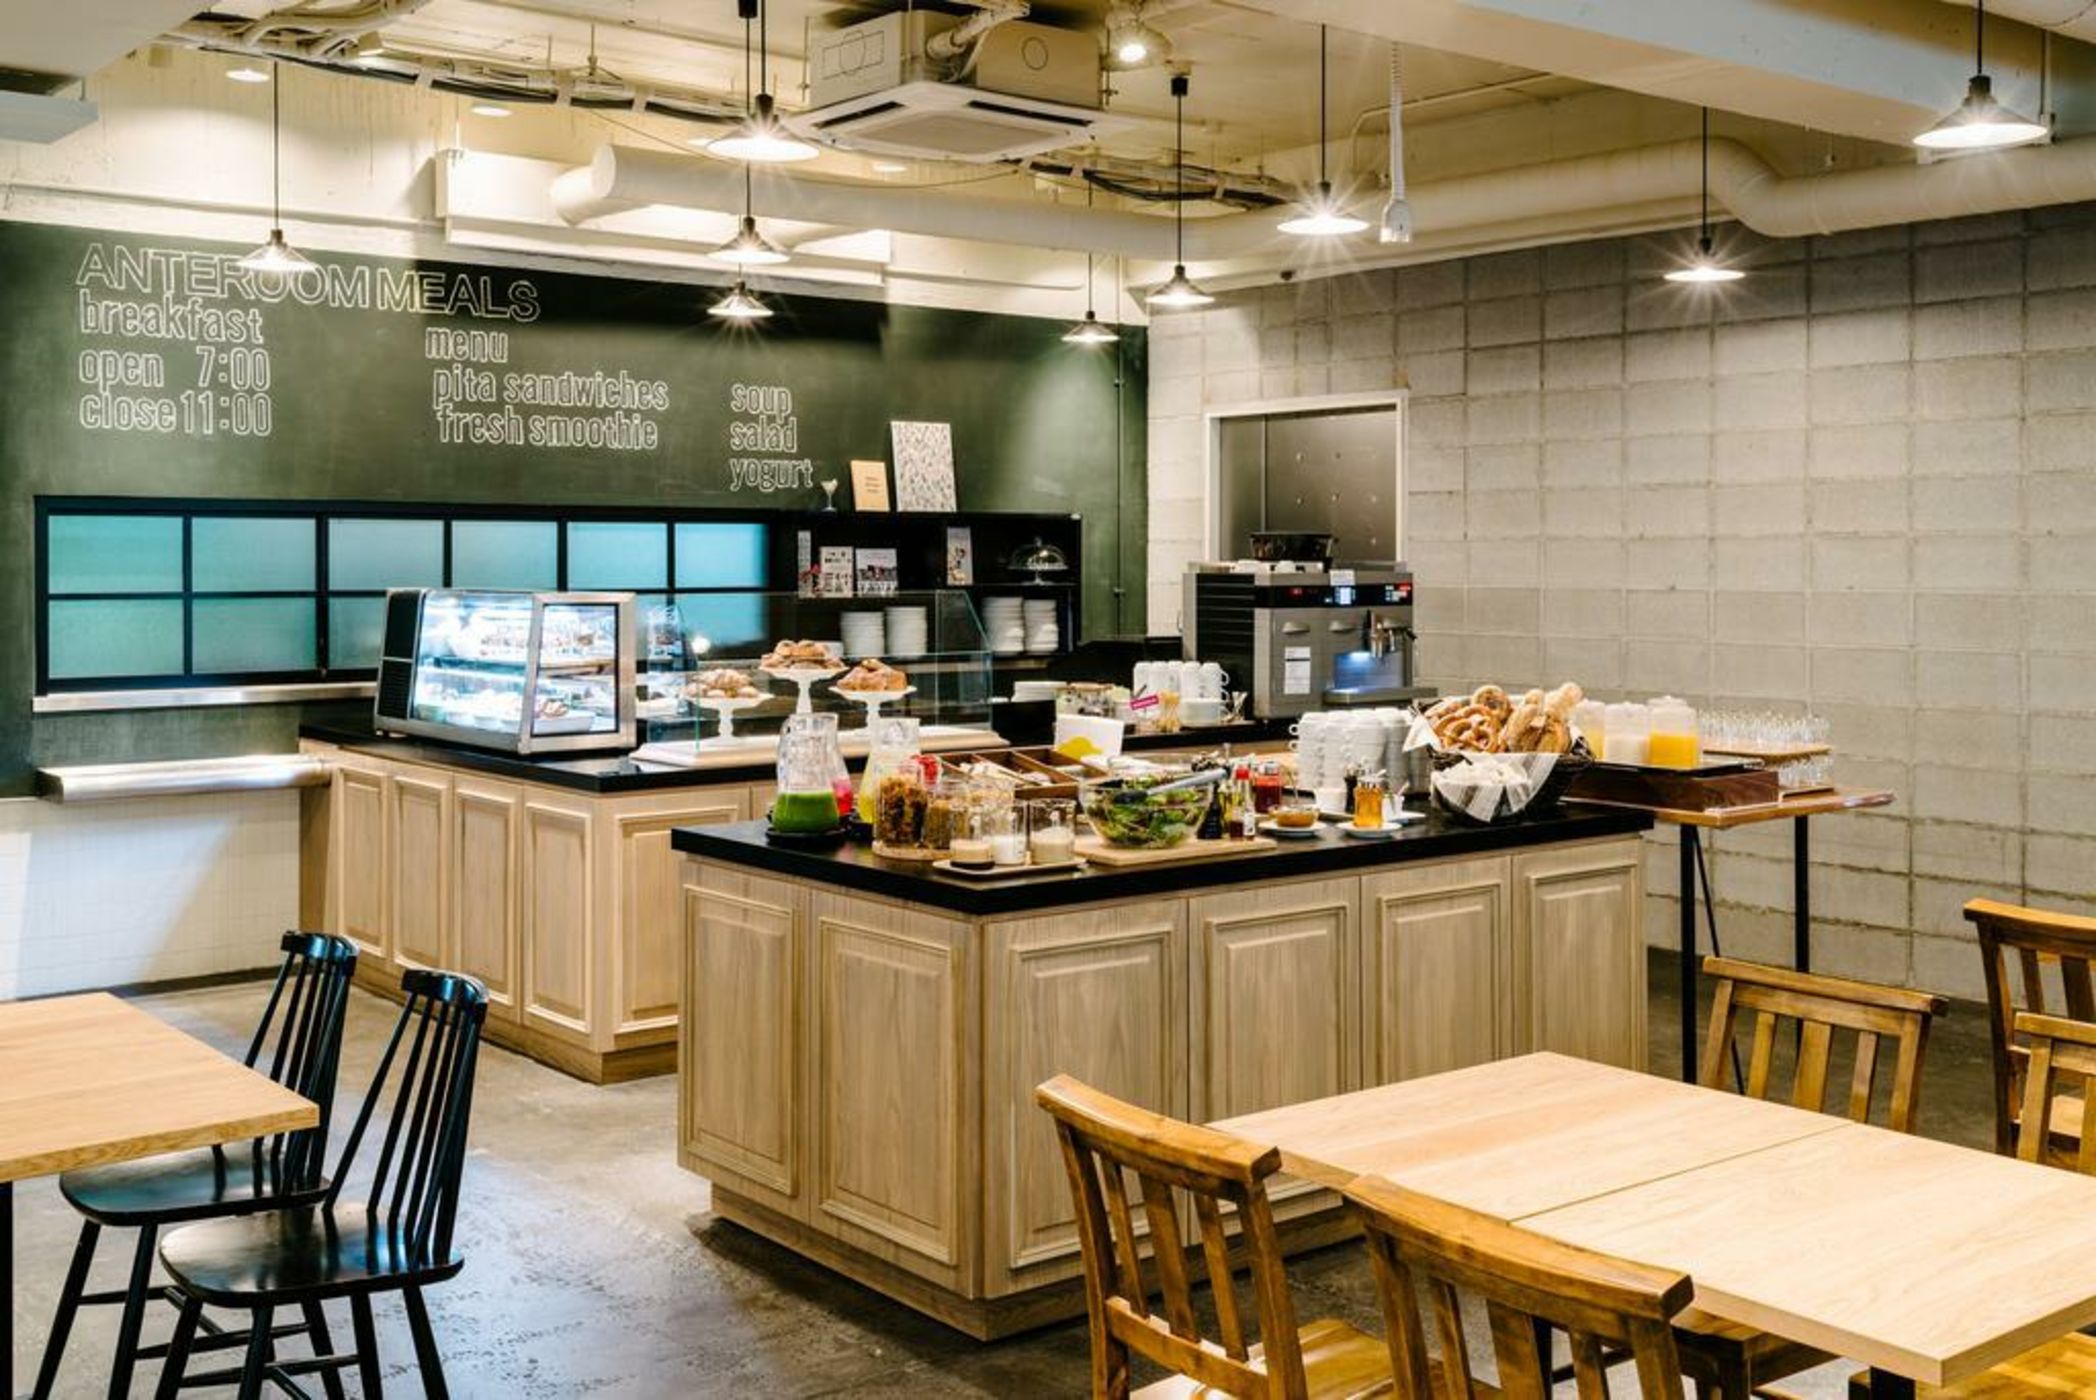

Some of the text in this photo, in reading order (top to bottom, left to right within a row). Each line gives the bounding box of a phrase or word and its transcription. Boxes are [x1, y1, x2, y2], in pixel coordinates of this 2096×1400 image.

[76, 244, 541, 322] ANTEROOM MEALS
[80, 289, 264, 344] breakfast
[426, 327, 508, 363] menu
[79, 346, 271, 393] open 7:00
[433, 364, 669, 411] pita sandwiches
[79, 391, 271, 436] close 11:00
[731, 382, 792, 422] soup
[437, 403, 657, 449] fresh smoothie
[730, 417, 797, 453] salad
[730, 457, 813, 492] yogurt
